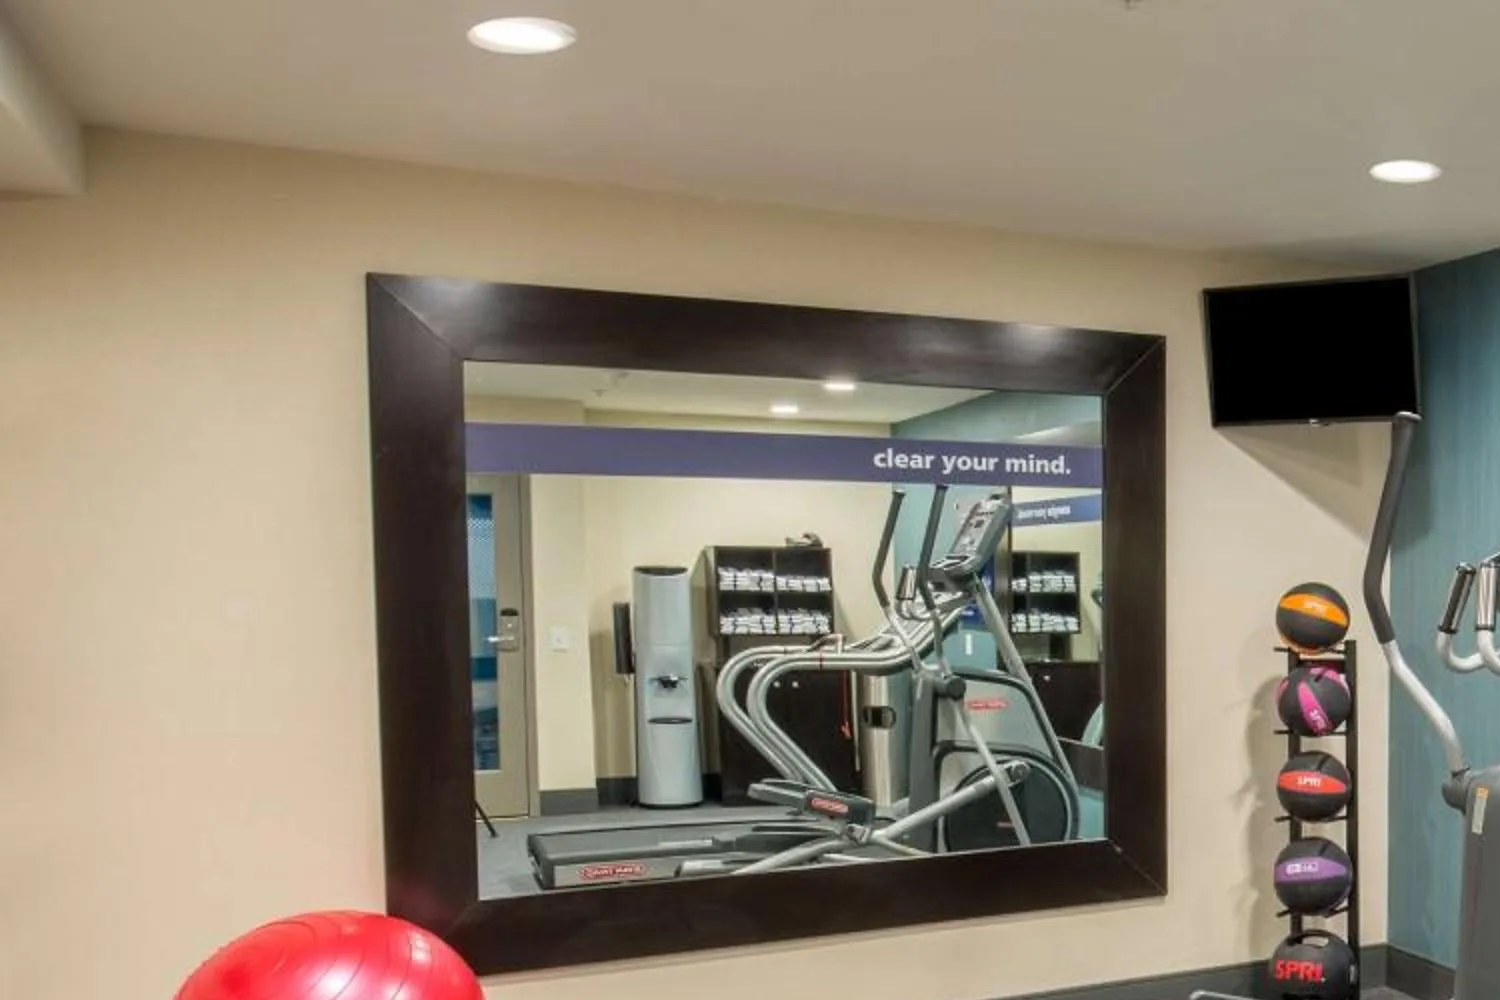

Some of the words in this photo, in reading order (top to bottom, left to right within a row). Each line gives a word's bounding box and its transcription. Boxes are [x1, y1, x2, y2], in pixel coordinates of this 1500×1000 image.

[873, 447, 935, 470] clear
[942, 454, 999, 475] your
[1005, 453, 1072, 475] mind.
